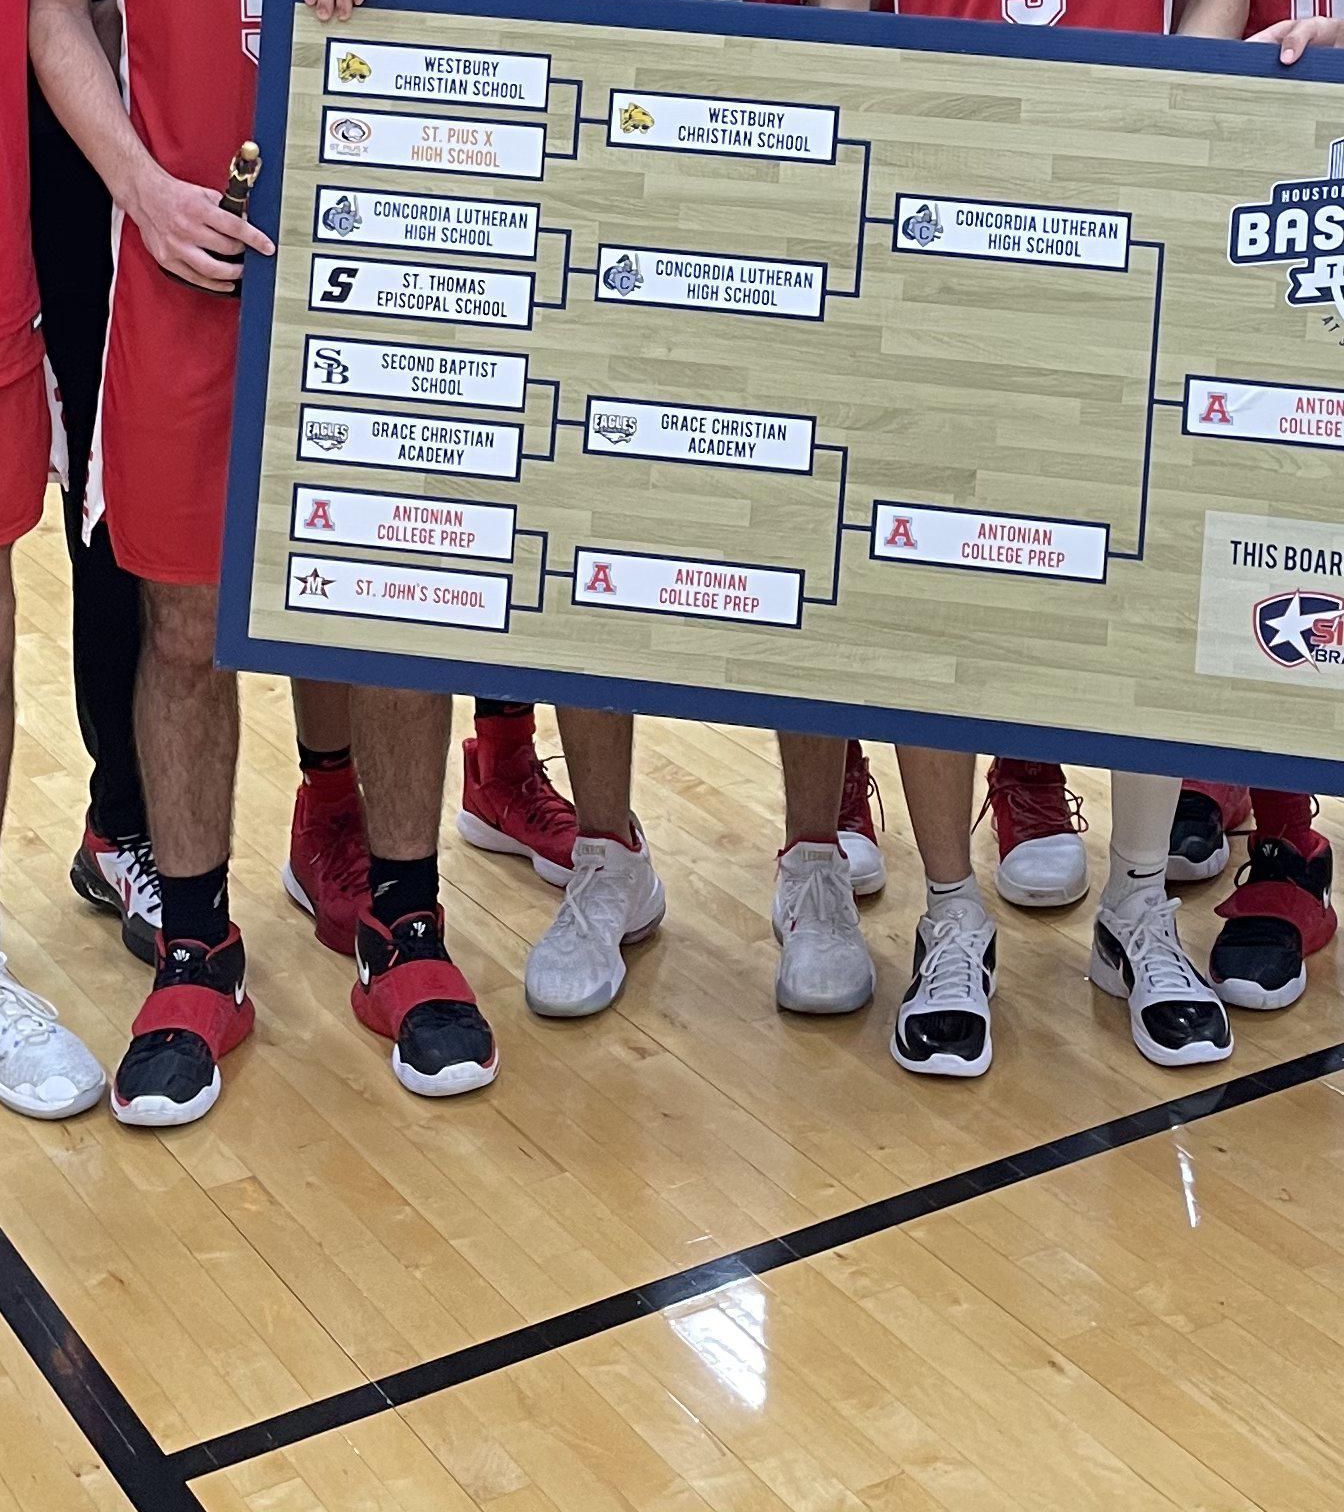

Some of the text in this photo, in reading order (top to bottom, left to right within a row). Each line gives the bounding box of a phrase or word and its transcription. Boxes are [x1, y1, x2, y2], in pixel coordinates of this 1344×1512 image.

[425, 56, 500, 77] WESTBURY
[395, 74, 525, 100] CHRISTIAN SCHOOL
[708, 107, 785, 129] WESTBURY
[421, 126, 493, 147] ST. PIUS X
[678, 125, 811, 152] CHRISTIAN SCHOOL
[411, 144, 500, 168] HIGH SCHOOL
[374, 201, 528, 229] CONCORDIA LUTHERAN
[956, 209, 1118, 240] CONCORDIA LUTHERAN
[404, 224, 493, 247] HIGH SCHOOL
[988, 233, 1081, 257] HIGH SCHOOL
[320, 266, 359, 304] S
[402, 272, 486, 296] ST. THOMAS
[656, 260, 814, 289] CONCORDIA LUTHERAN
[377, 290, 508, 318] EPISCOPAL SCHOOL
[687, 283, 778, 306] HIGH SCHOOL
[1321, 314, 1340, 333] AT
[381, 353, 497, 379] SECOND BAPTIST
[411, 376, 464, 396] SCHOOL
[1199, 391, 1233, 425] A
[305, 420, 349, 441] EAGLES
[372, 421, 494, 448] GRACE CHRISTIAN
[593, 414, 637, 435] EAGLES
[661, 414, 787, 441] GRACE CHRISTIAN
[1279, 417, 1342, 438] COLLEGE
[398, 444, 465, 466] ACADEMY
[688, 437, 757, 459] ACADEMY
[304, 498, 336, 531] A
[392, 505, 464, 527] ANTONIAN
[377, 524, 475, 549] COLLEGE PREP
[884, 515, 917, 550] A
[978, 523, 1053, 546] ANTONIAN
[961, 542, 1065, 568] COLLEGE PREP
[1230, 540, 1277, 569] THIS
[584, 561, 617, 595] A
[675, 569, 748, 592] ANTONIAN
[355, 579, 486, 609] ST. JOHN'S SCHOOL
[659, 588, 760, 614] COLLEGE PREP
